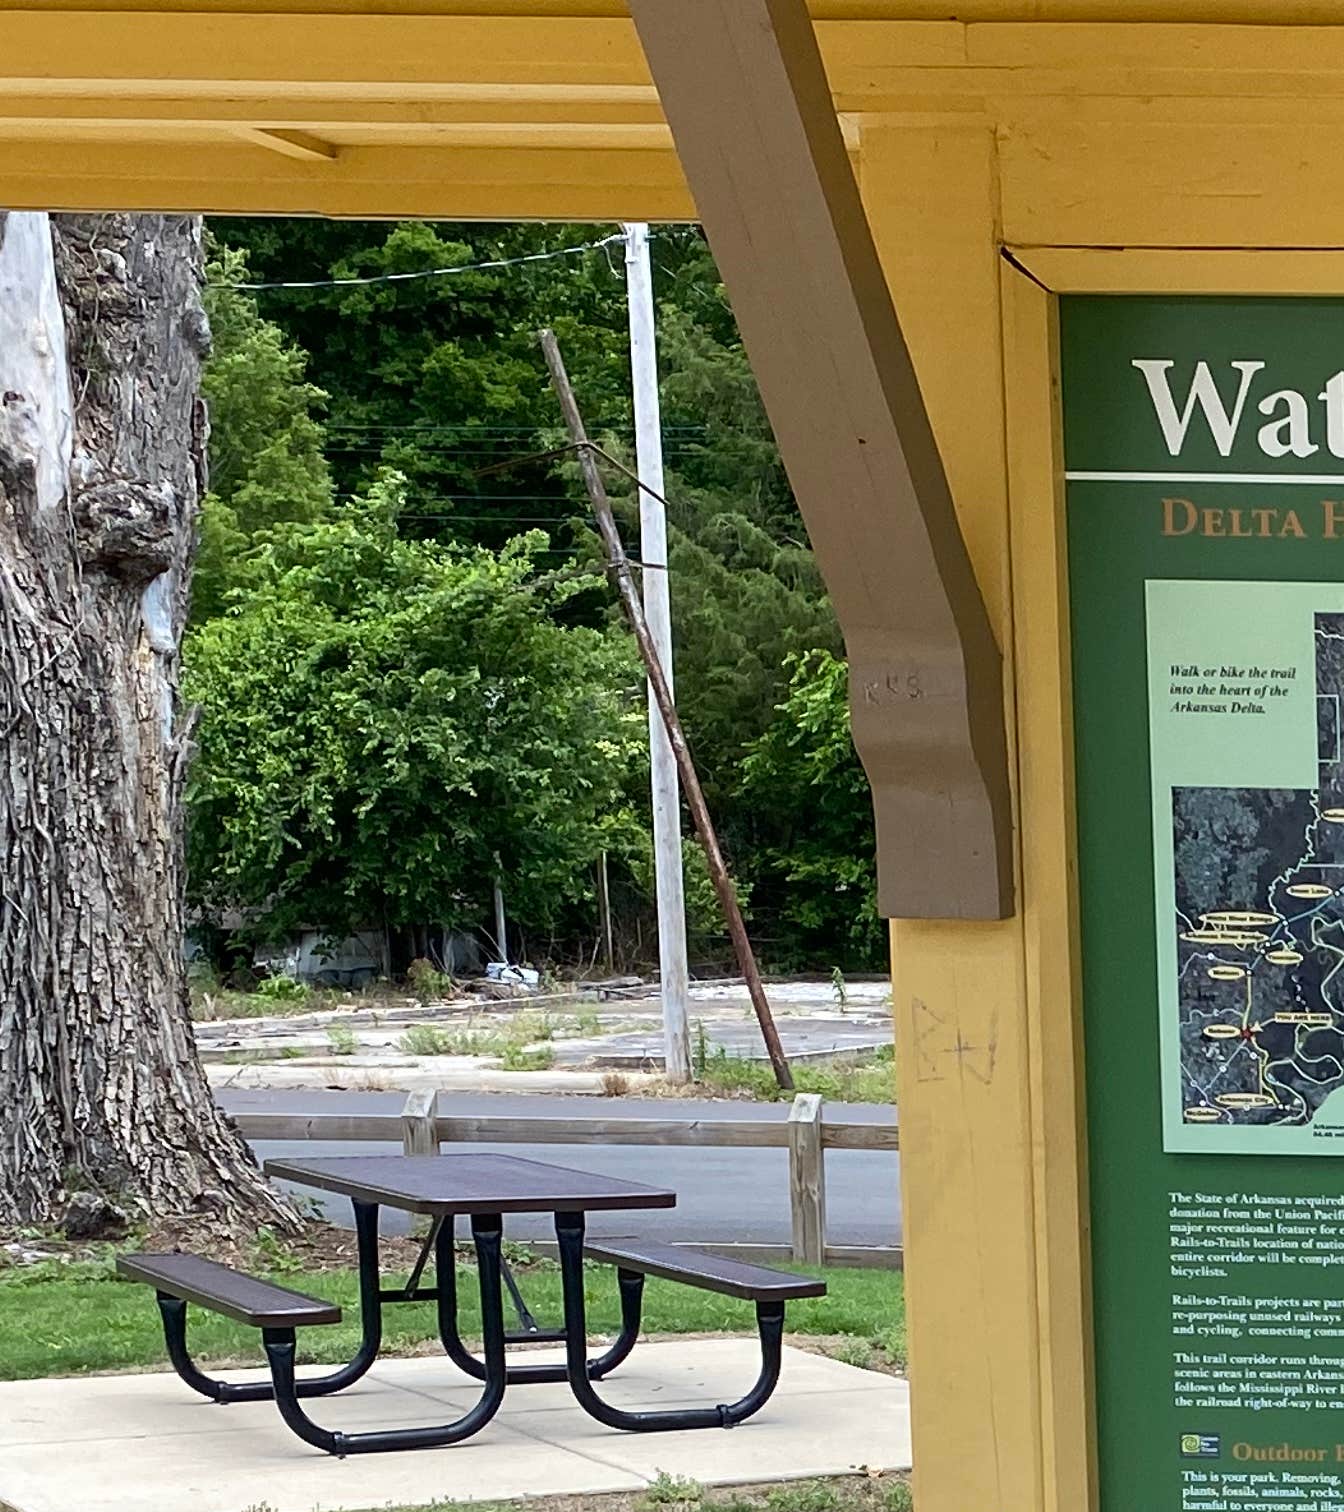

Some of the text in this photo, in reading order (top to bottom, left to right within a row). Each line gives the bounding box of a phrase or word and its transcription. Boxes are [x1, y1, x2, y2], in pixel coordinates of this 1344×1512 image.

[1162, 498, 1304, 538] DELTA
[1171, 666, 1296, 678] Walk or bike the trail
[1170, 684, 1288, 698] into the heart of the
[1171, 701, 1265, 713] Arkansas Delta.
[1169, 1193, 1192, 1203] The
[1195, 1193, 1222, 1203] State
[1226, 1193, 1238, 1204] of
[1241, 1194, 1292, 1204] Arkansas
[1295, 1194, 1344, 1209] acquired
[1232, 1444, 1326, 1463] Outdoor
[1182, 1471, 1207, 1482] This
[1210, 1472, 1219, 1482] is
[1222, 1474, 1247, 1484] your
[1250, 1473, 1278, 1486] park.
[1283, 1472, 1341, 1487] Removing,
[1183, 1485, 1219, 1499] plants,
[1223, 1485, 1258, 1497] fossils,
[1262, 1486, 1308, 1498] animals,
[1311, 1487, 1343, 1498] rocks,
[1183, 1500, 1227, 1510] harmful
[1230, 1502, 1241, 1510] to
[1296, 1501, 1317, 1512] and
